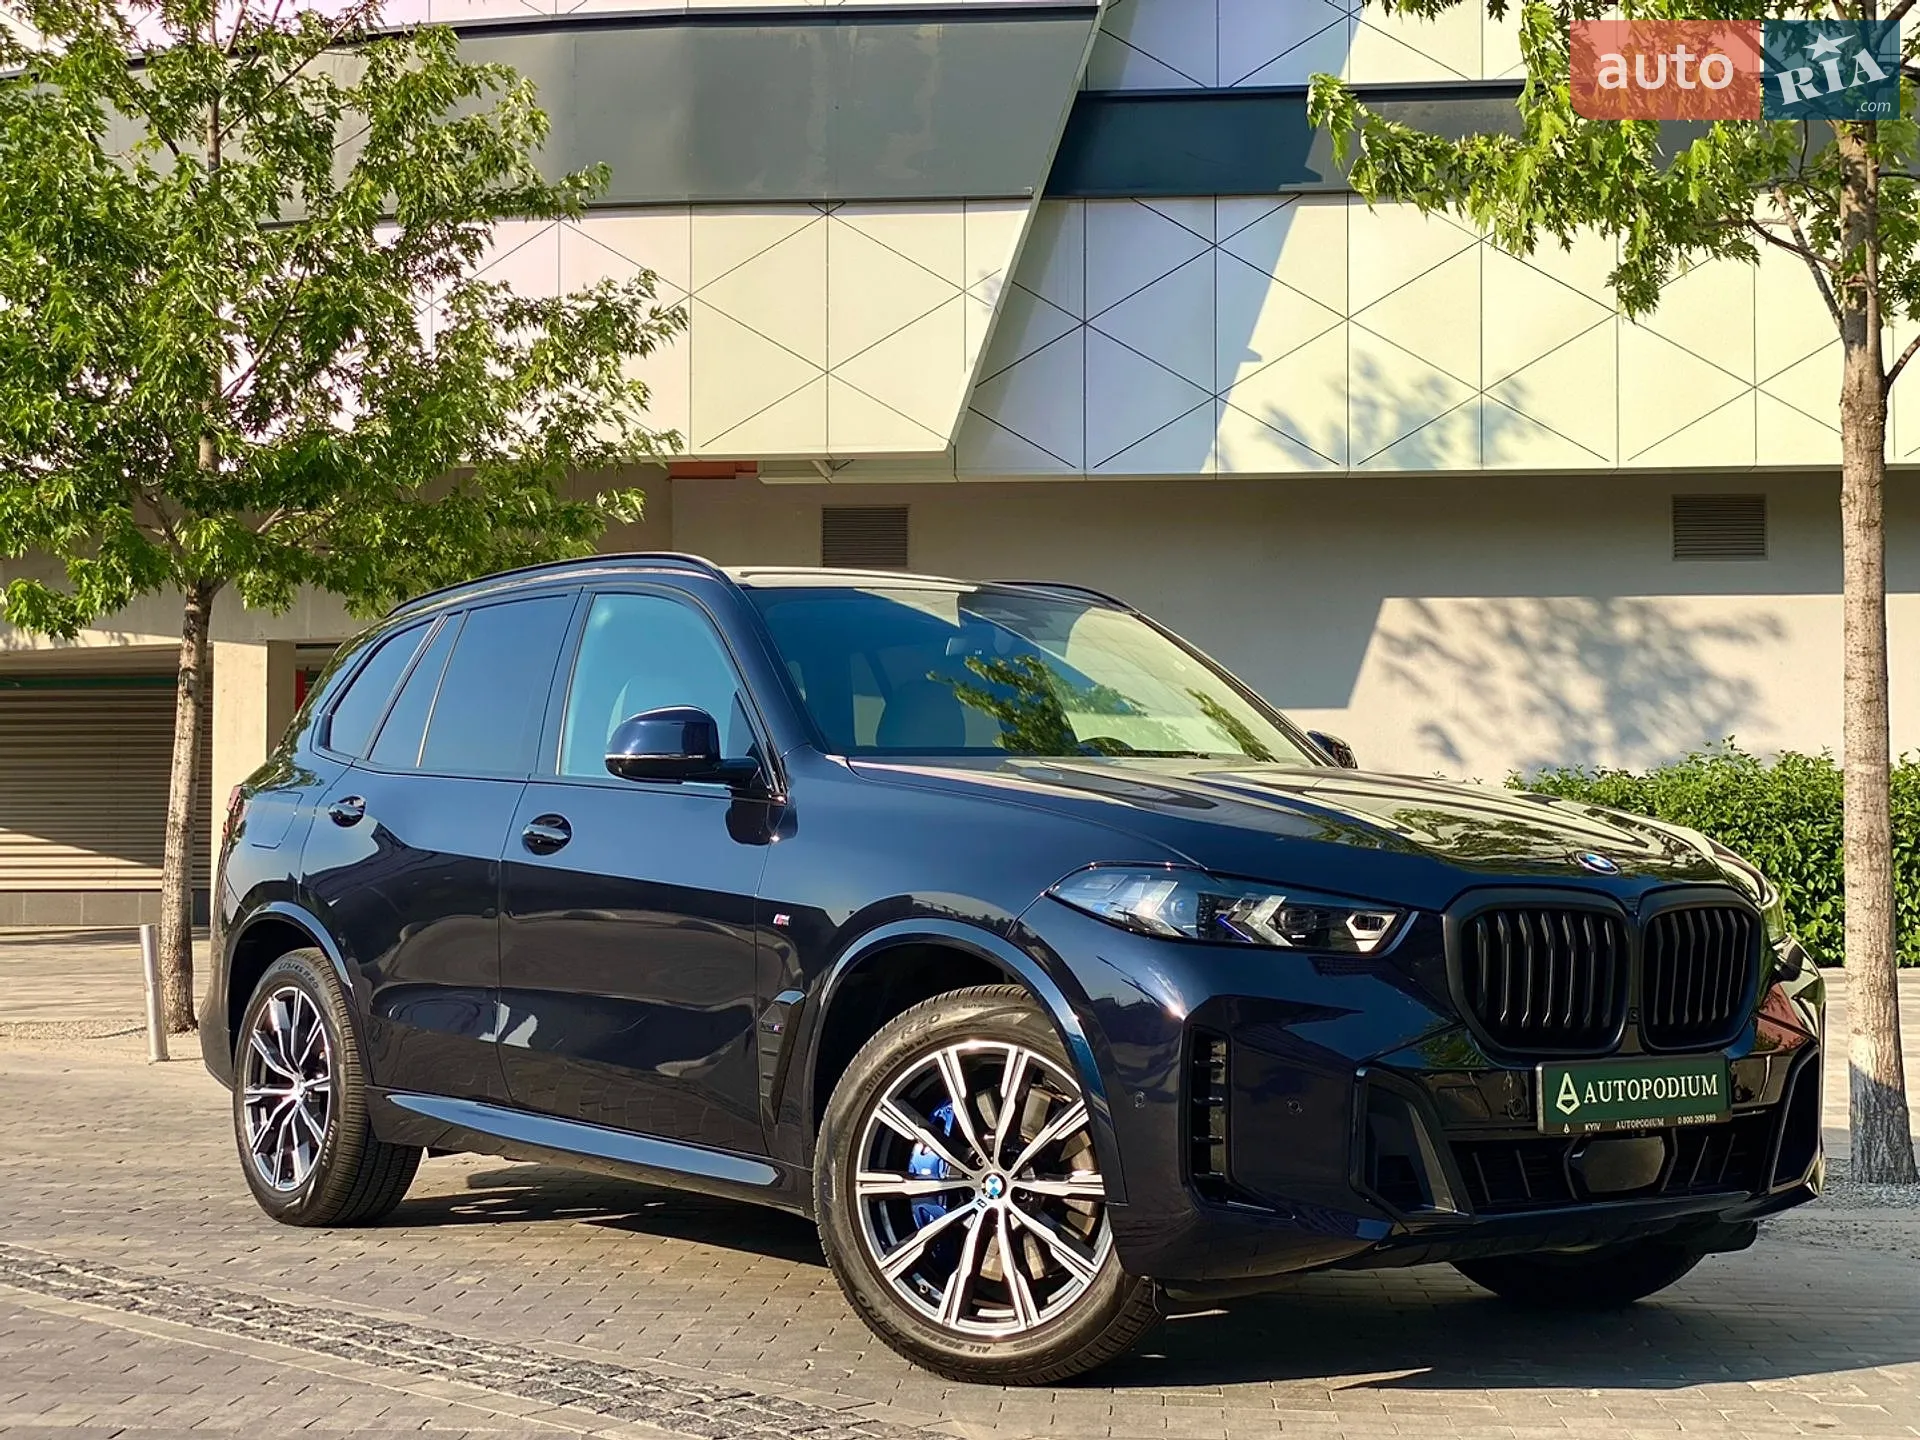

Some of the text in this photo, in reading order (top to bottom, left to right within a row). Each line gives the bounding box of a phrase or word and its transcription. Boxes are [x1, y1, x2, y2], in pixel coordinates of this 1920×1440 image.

[1583, 1074, 1719, 1104] AUTOPODIUM
[1584, 1122, 1602, 1131] KYIV
[1615, 1117, 1664, 1130] AUTOPODIUM
